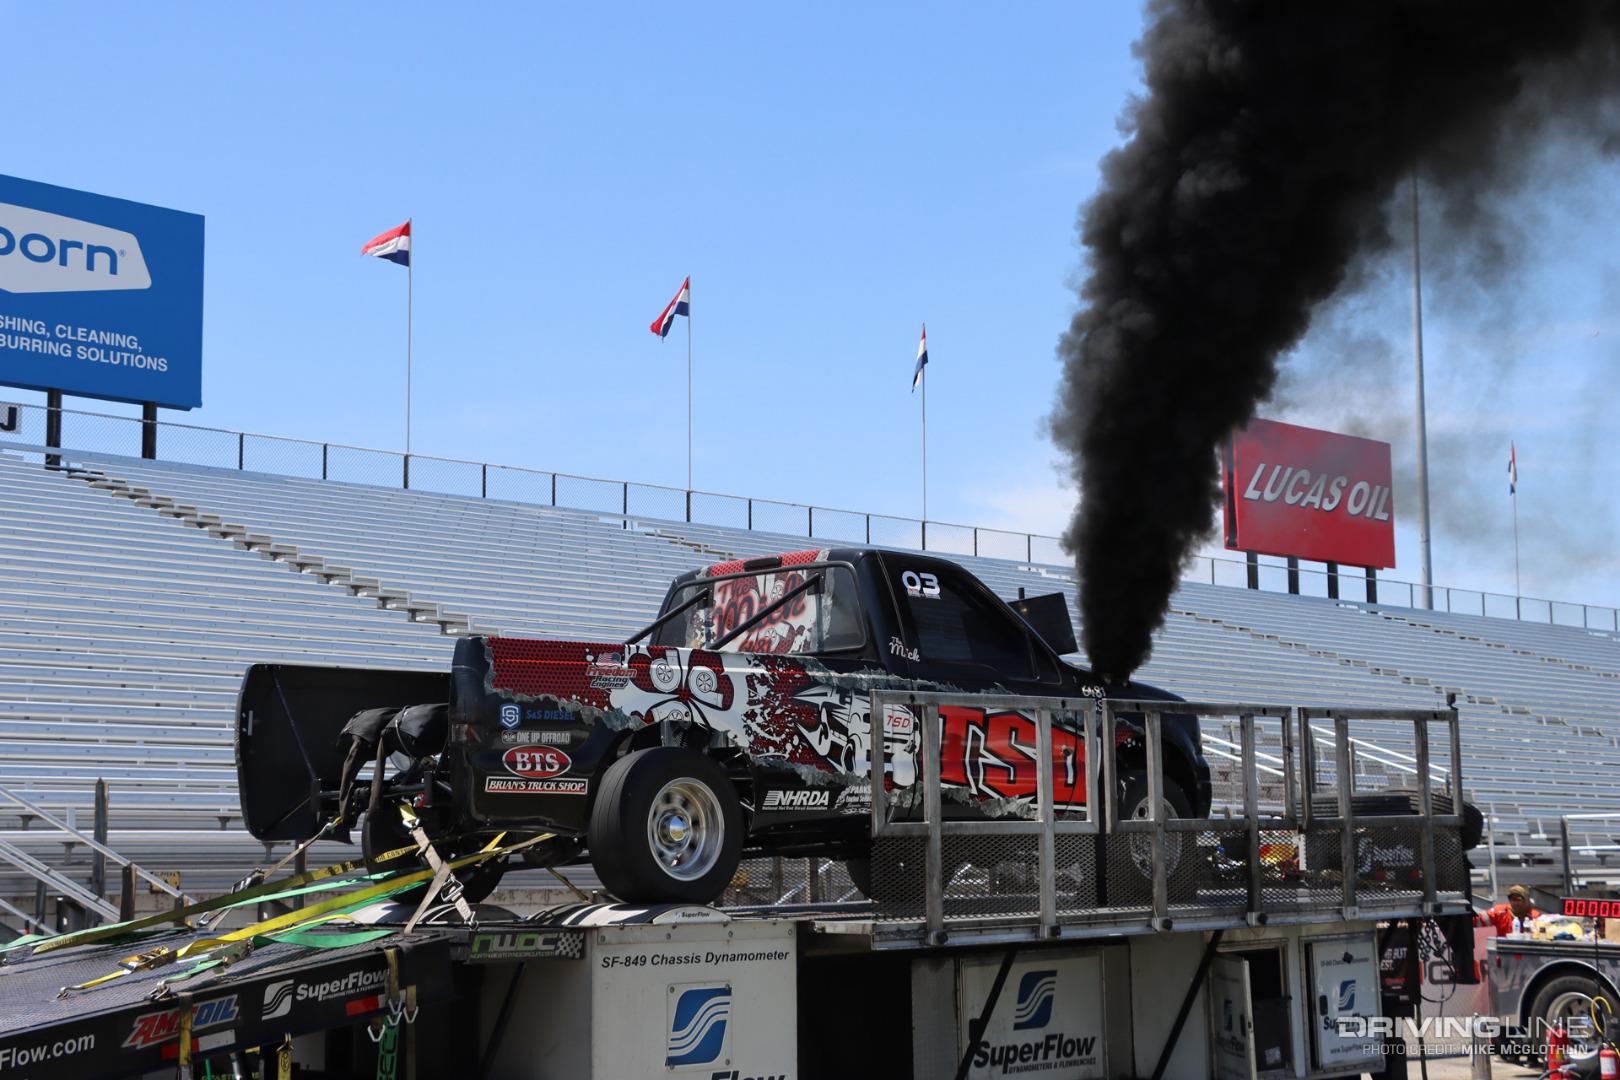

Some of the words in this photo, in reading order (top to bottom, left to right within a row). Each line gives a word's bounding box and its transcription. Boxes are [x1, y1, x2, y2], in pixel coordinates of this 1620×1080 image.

[55, 324, 142, 352] CLEANING,
[76, 345, 168, 372] SOLUTIONS
[1243, 462, 1348, 512] LUCAS
[1347, 480, 1391, 522] OIL
[717, 580, 751, 603] The
[901, 570, 941, 595] 03
[587, 665, 636, 677] Freedom
[594, 675, 628, 685] Racing
[526, 710, 542, 719] S&S
[543, 710, 575, 720] DIESEL
[886, 715, 911, 729] TSD
[517, 731, 530, 743] ONE
[531, 732, 541, 743] UP
[541, 732, 570, 743] OFFROAD
[515, 752, 560, 772] BTS
[489, 780, 527, 790] BRIAN'S
[528, 781, 557, 790] TRUCK
[772, 790, 830, 806] NHRDA
[601, 955, 648, 969] SF-849
[650, 952, 702, 966] Chassis
[704, 949, 790, 966] Dynamometer
[296, 968, 388, 1002] SuperFlow
[974, 1033, 1096, 1075] SuperFlow
[1008, 1061, 1053, 1075] DYNAMOMETERS
[1059, 1057, 1097, 1069] FLOWBENCHES
